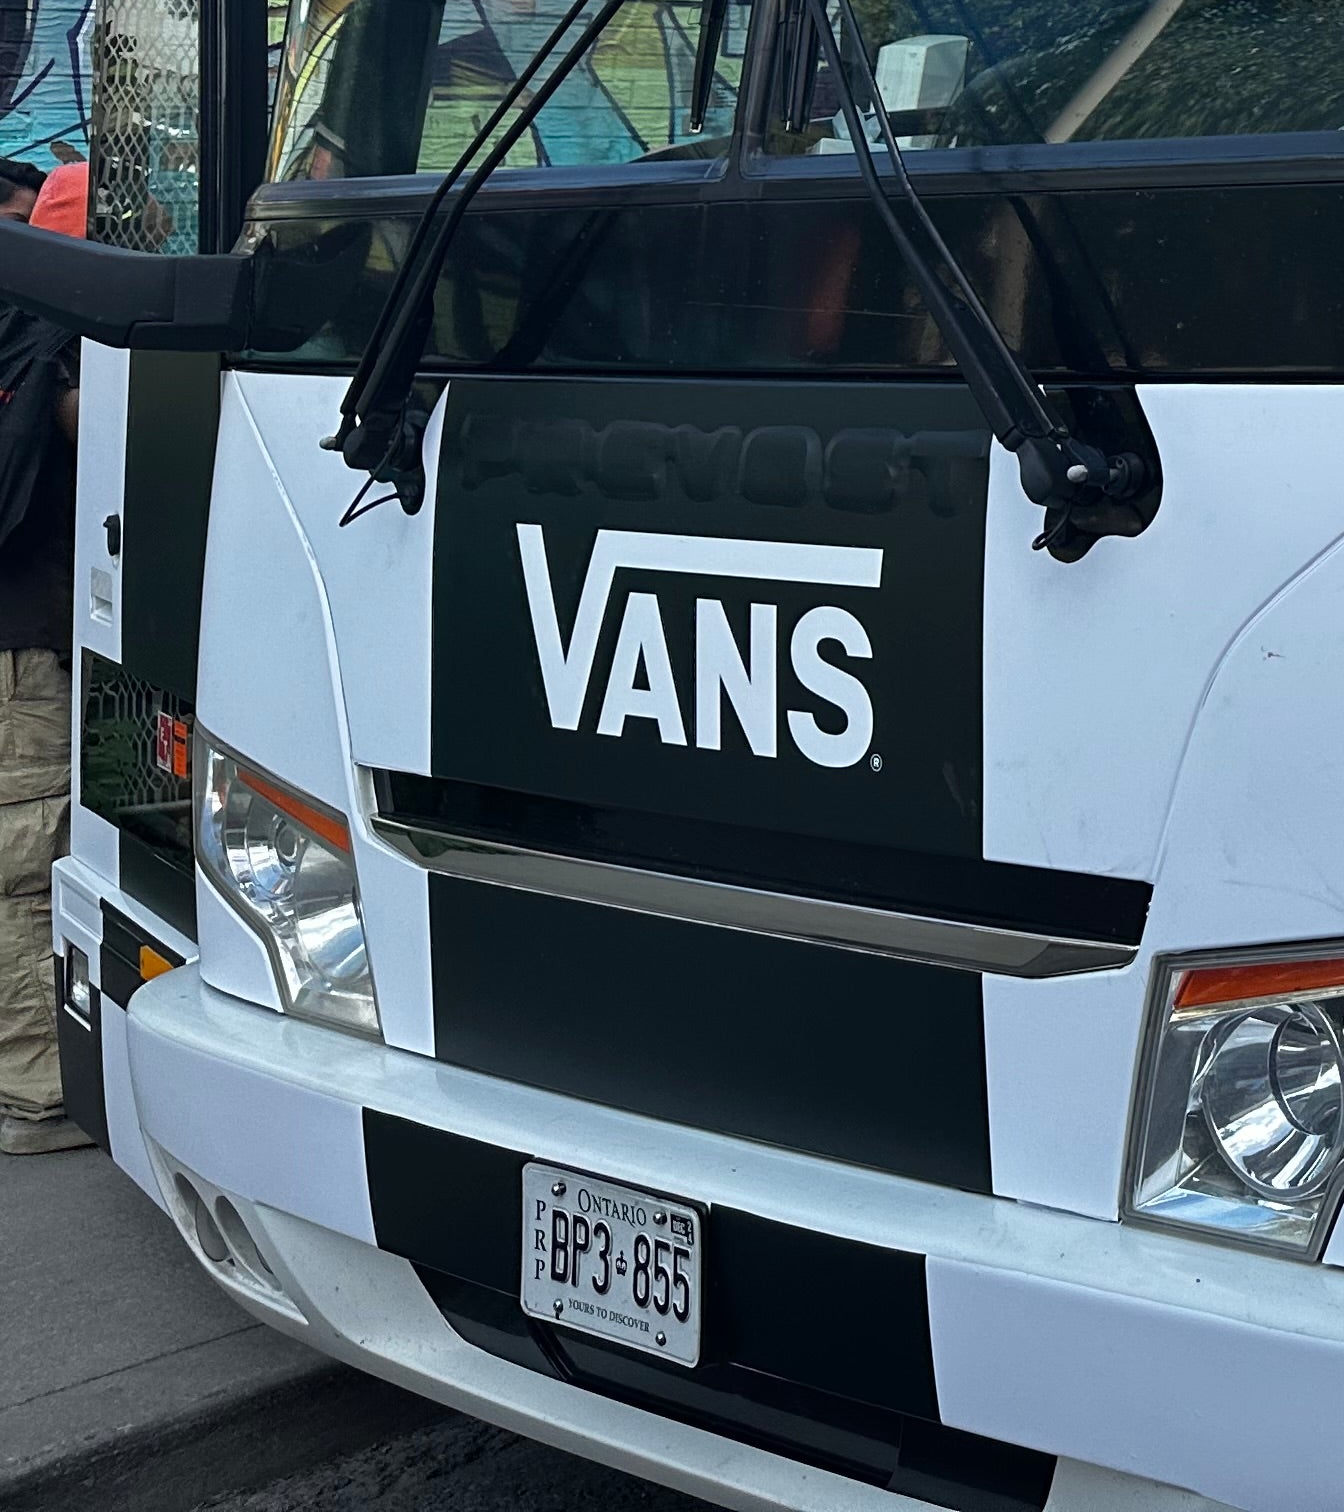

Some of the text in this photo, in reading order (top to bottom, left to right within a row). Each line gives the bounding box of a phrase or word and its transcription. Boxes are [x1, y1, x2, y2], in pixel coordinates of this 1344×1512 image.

[516, 523, 884, 768] VANS
[578, 1189, 647, 1228] ONTARIO
[551, 1208, 690, 1323] BP3 855
[568, 1298, 649, 1332] YOURS TO DISCOVER
